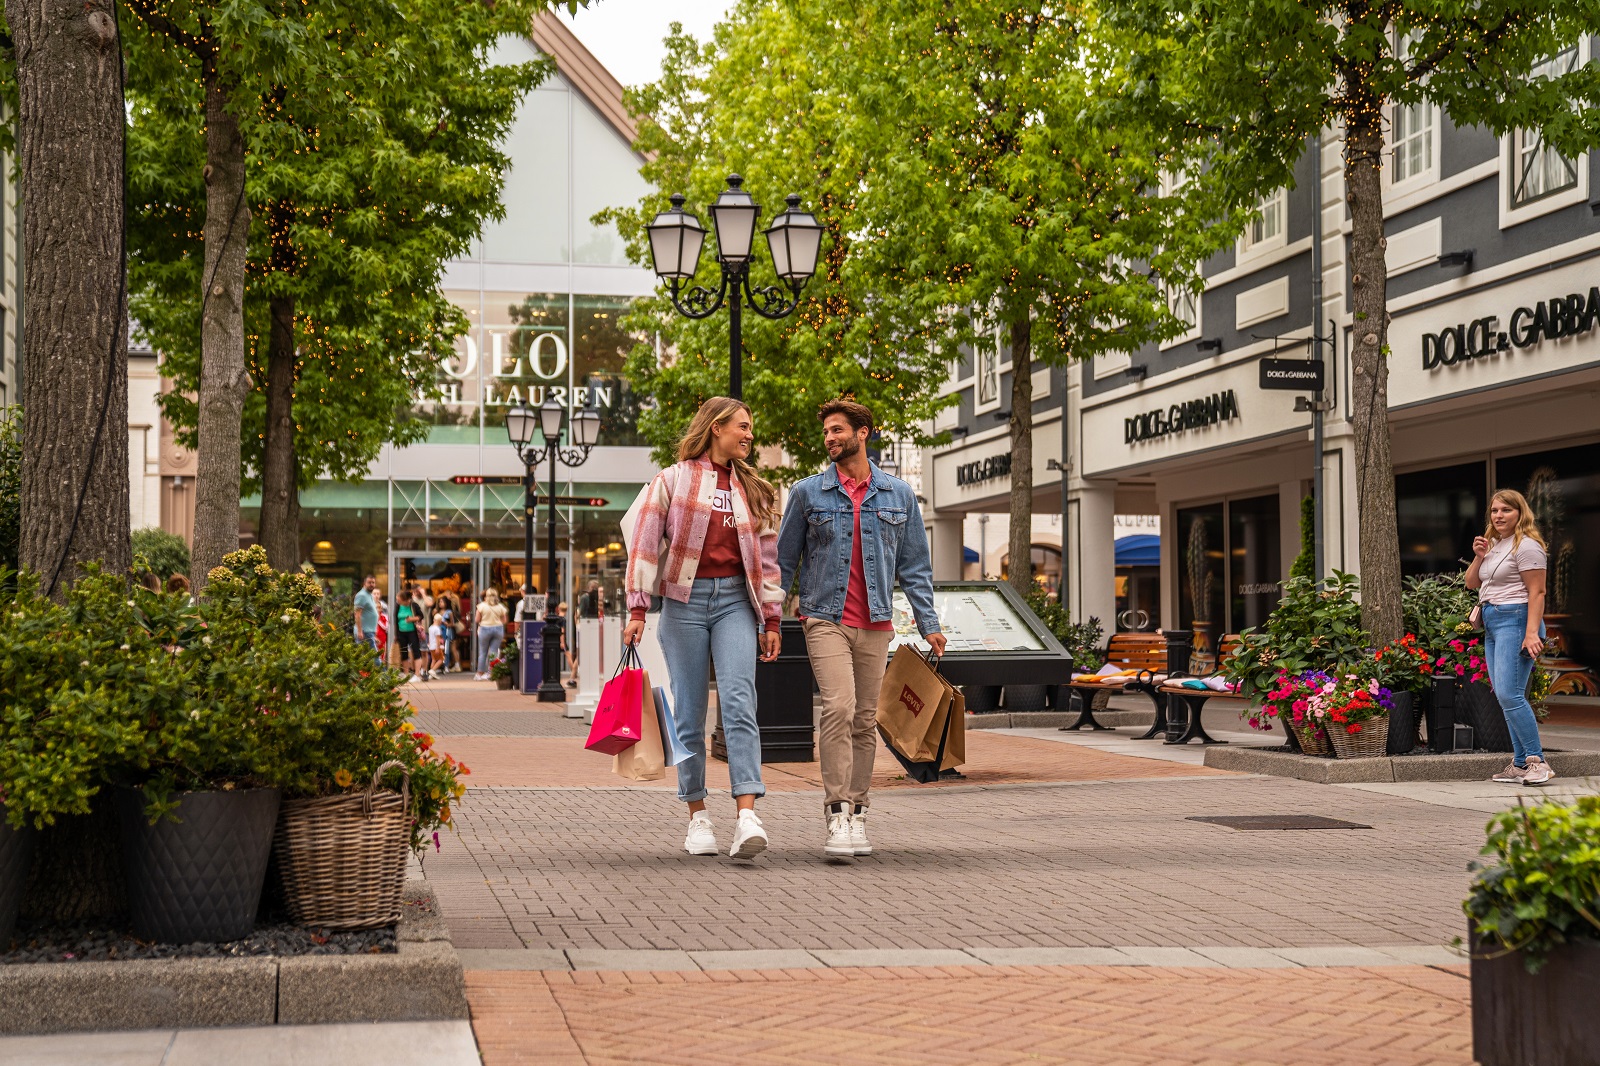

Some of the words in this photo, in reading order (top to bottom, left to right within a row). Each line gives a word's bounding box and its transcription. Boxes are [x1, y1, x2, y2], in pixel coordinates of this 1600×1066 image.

[441, 332, 568, 379] OLO
[486, 384, 612, 408] LAUREN
[1114, 515, 1156, 527] ALPH
